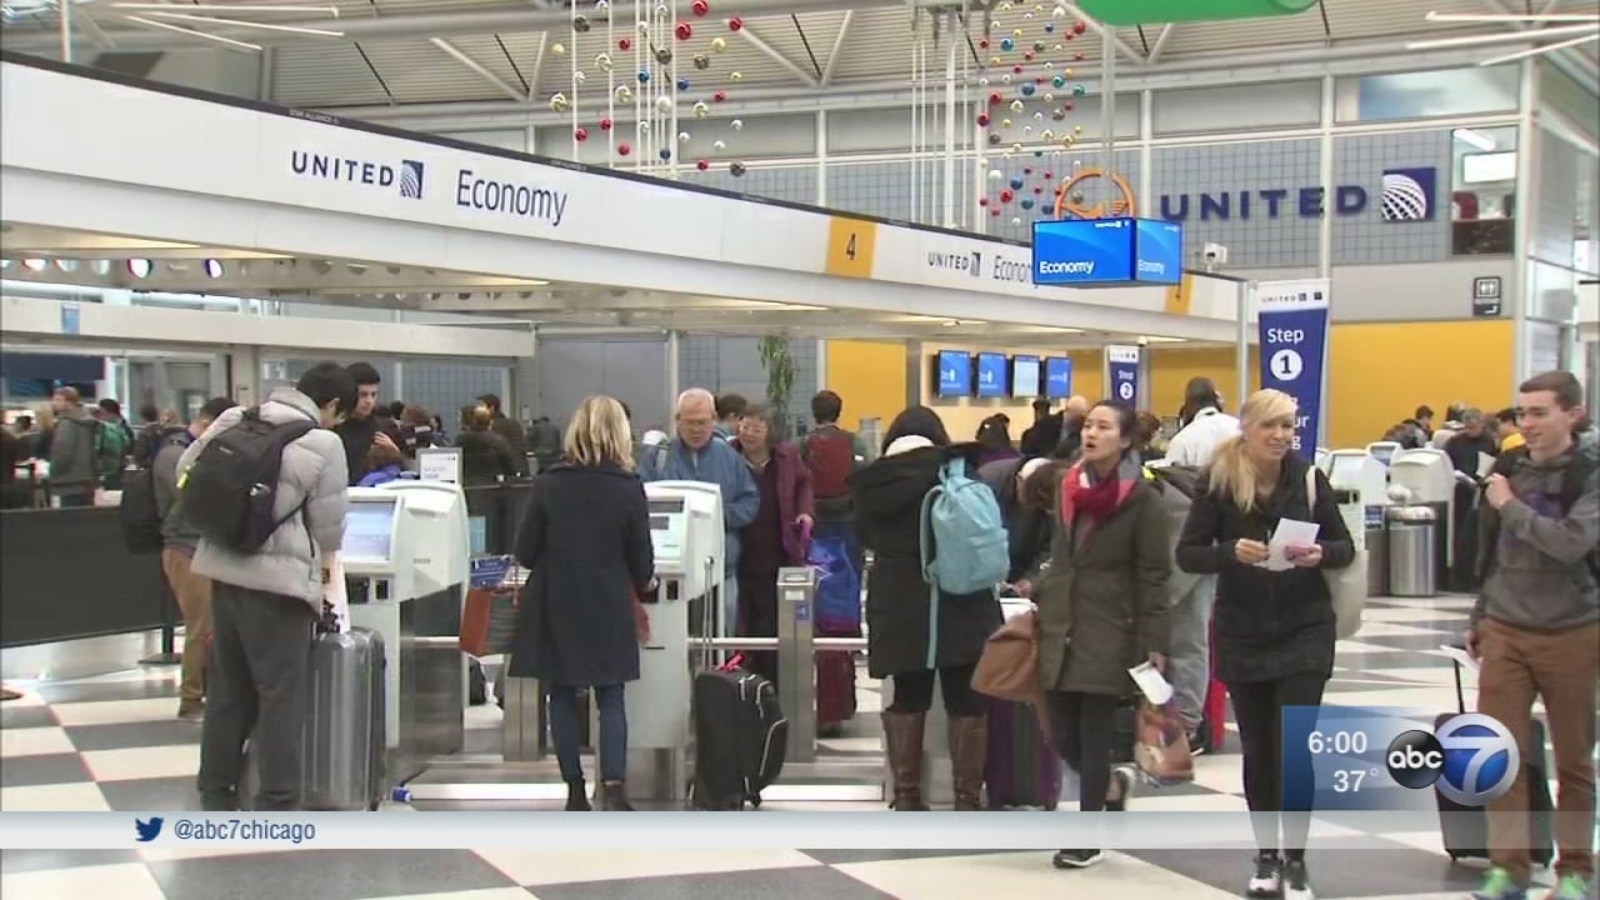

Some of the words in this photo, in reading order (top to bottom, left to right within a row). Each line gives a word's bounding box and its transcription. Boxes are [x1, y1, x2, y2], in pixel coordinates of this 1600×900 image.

[292, 150, 395, 187] UNITED
[456, 169, 568, 227] Economy
[1160, 185, 1367, 222] UNITED
[845, 232, 857, 261] 4
[928, 251, 969, 271] UNITED
[1039, 260, 1095, 275] Economy
[1138, 259, 1165, 275] Economy
[1266, 327, 1305, 345] Step
[1279, 354, 1292, 375] 1
